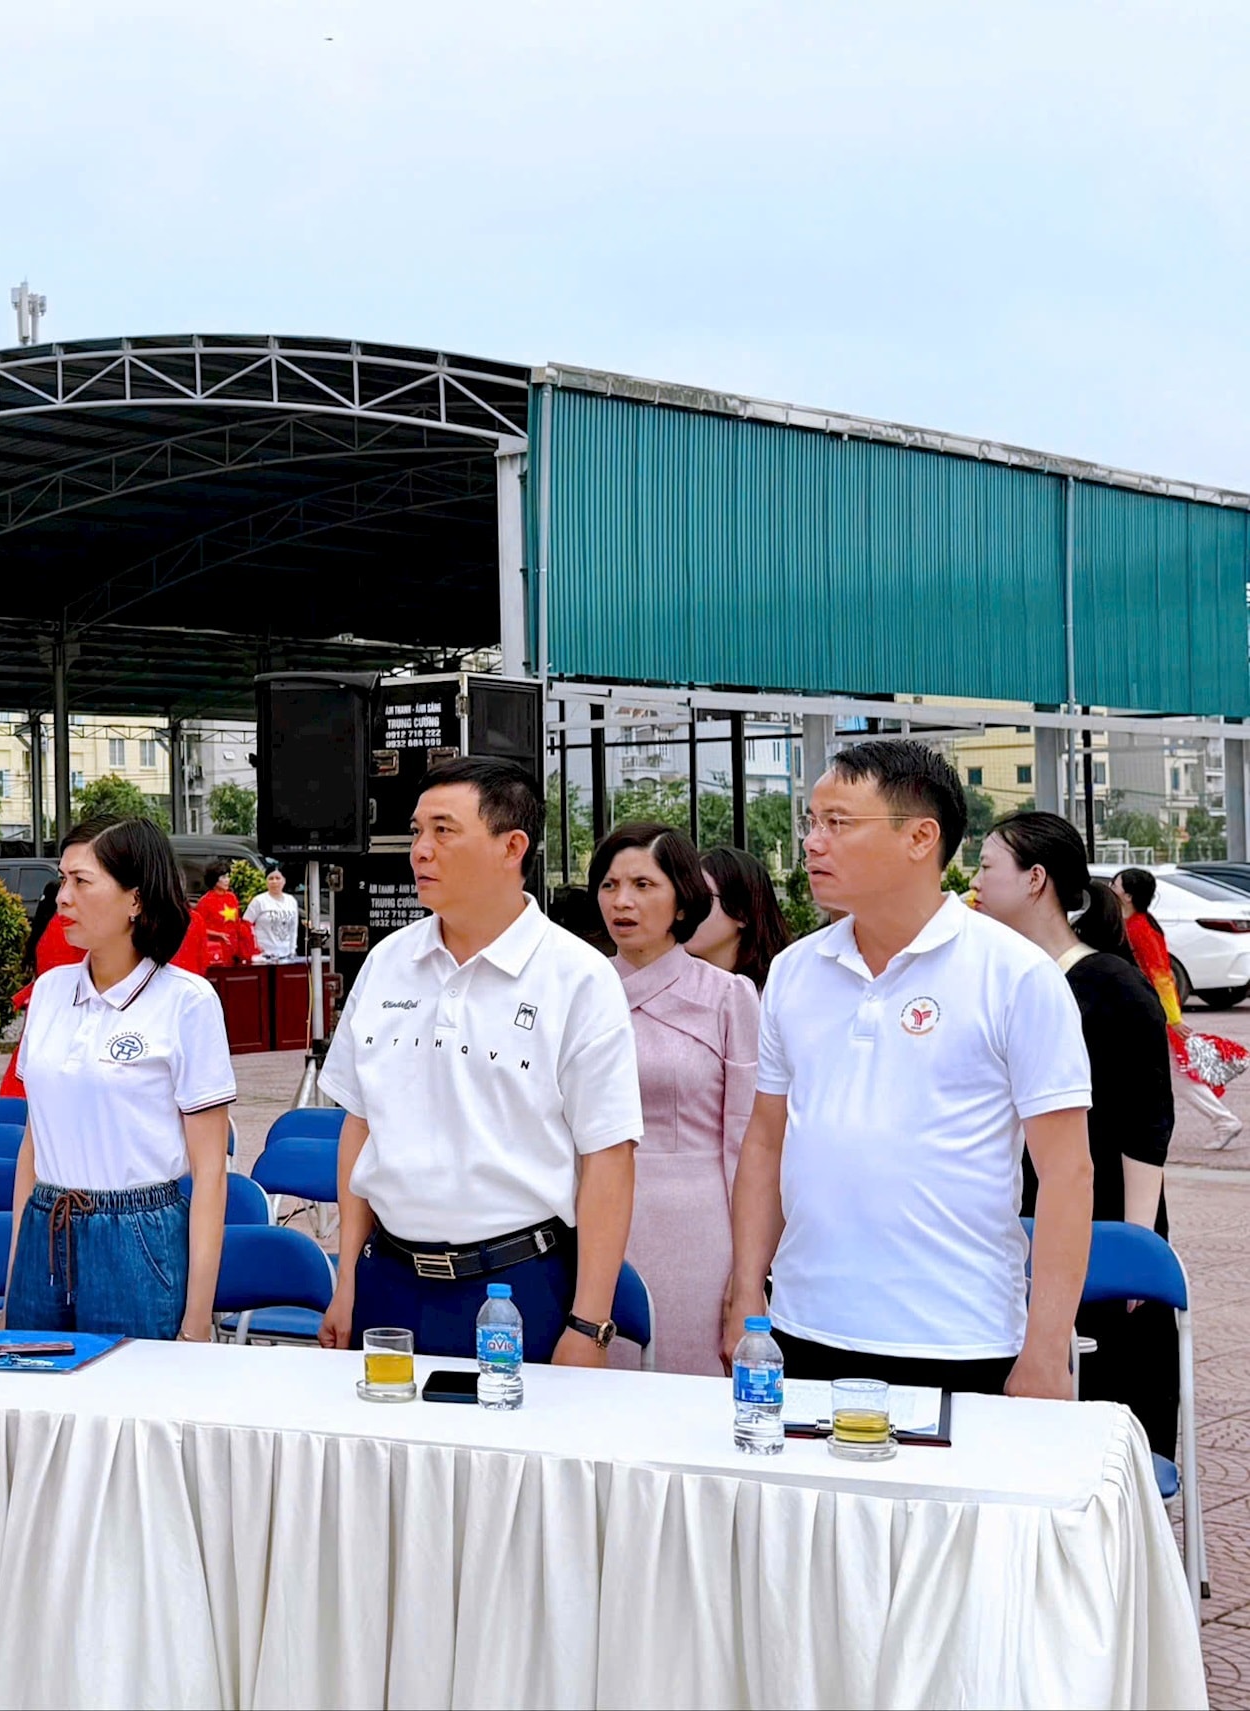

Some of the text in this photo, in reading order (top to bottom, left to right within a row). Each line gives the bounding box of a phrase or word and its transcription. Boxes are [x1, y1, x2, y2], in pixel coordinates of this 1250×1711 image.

[387, 718, 412, 729] TRUNG
[385, 730, 406, 739] 0912
[425, 729, 441, 737] 222
[359, 881, 365, 889] 2
[371, 898, 395, 908] TRUNG
[370, 910, 390, 918] 0912
[409, 910, 425, 918] 222
